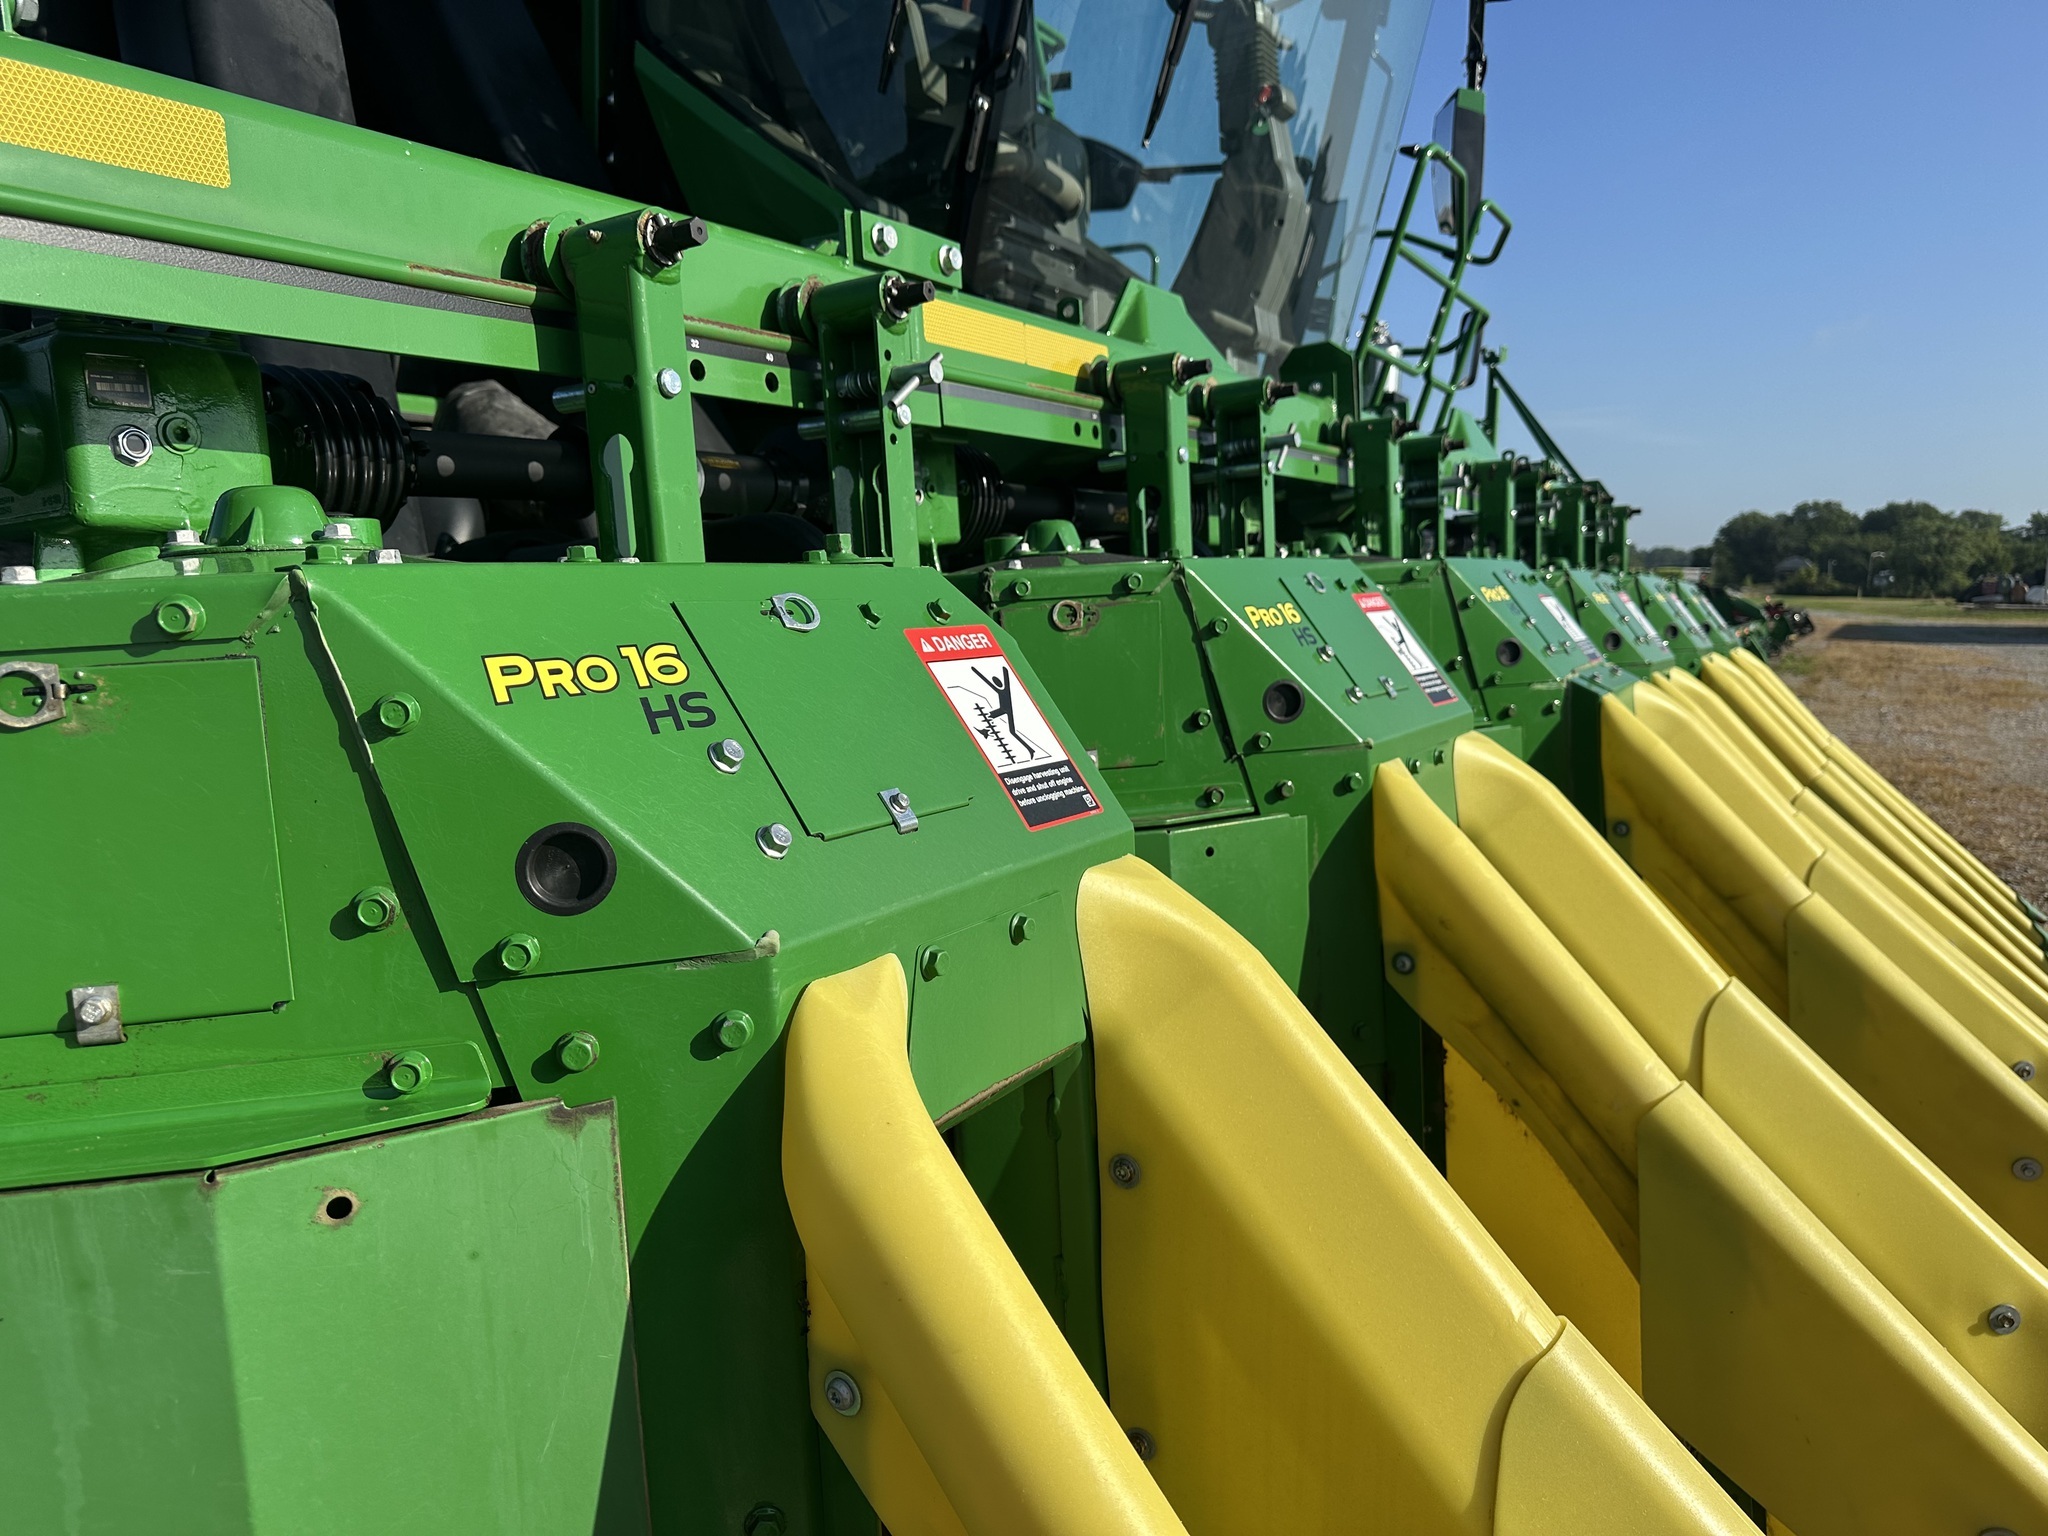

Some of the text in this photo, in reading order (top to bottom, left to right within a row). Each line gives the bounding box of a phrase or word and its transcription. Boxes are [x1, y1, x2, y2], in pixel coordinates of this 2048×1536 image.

[690, 338, 700, 349] 32
[1276, 602, 1302, 625] 16
[931, 633, 993, 652] DANGER
[1291, 626, 1318, 647] HS
[616, 642, 690, 690] 16
[639, 691, 717, 735] HS
[1004, 765, 1070, 785] Disengage harvesting unit
[1012, 777, 1073, 796] drive and shut off engine
[1017, 785, 1086, 807] before unclogging machine.
